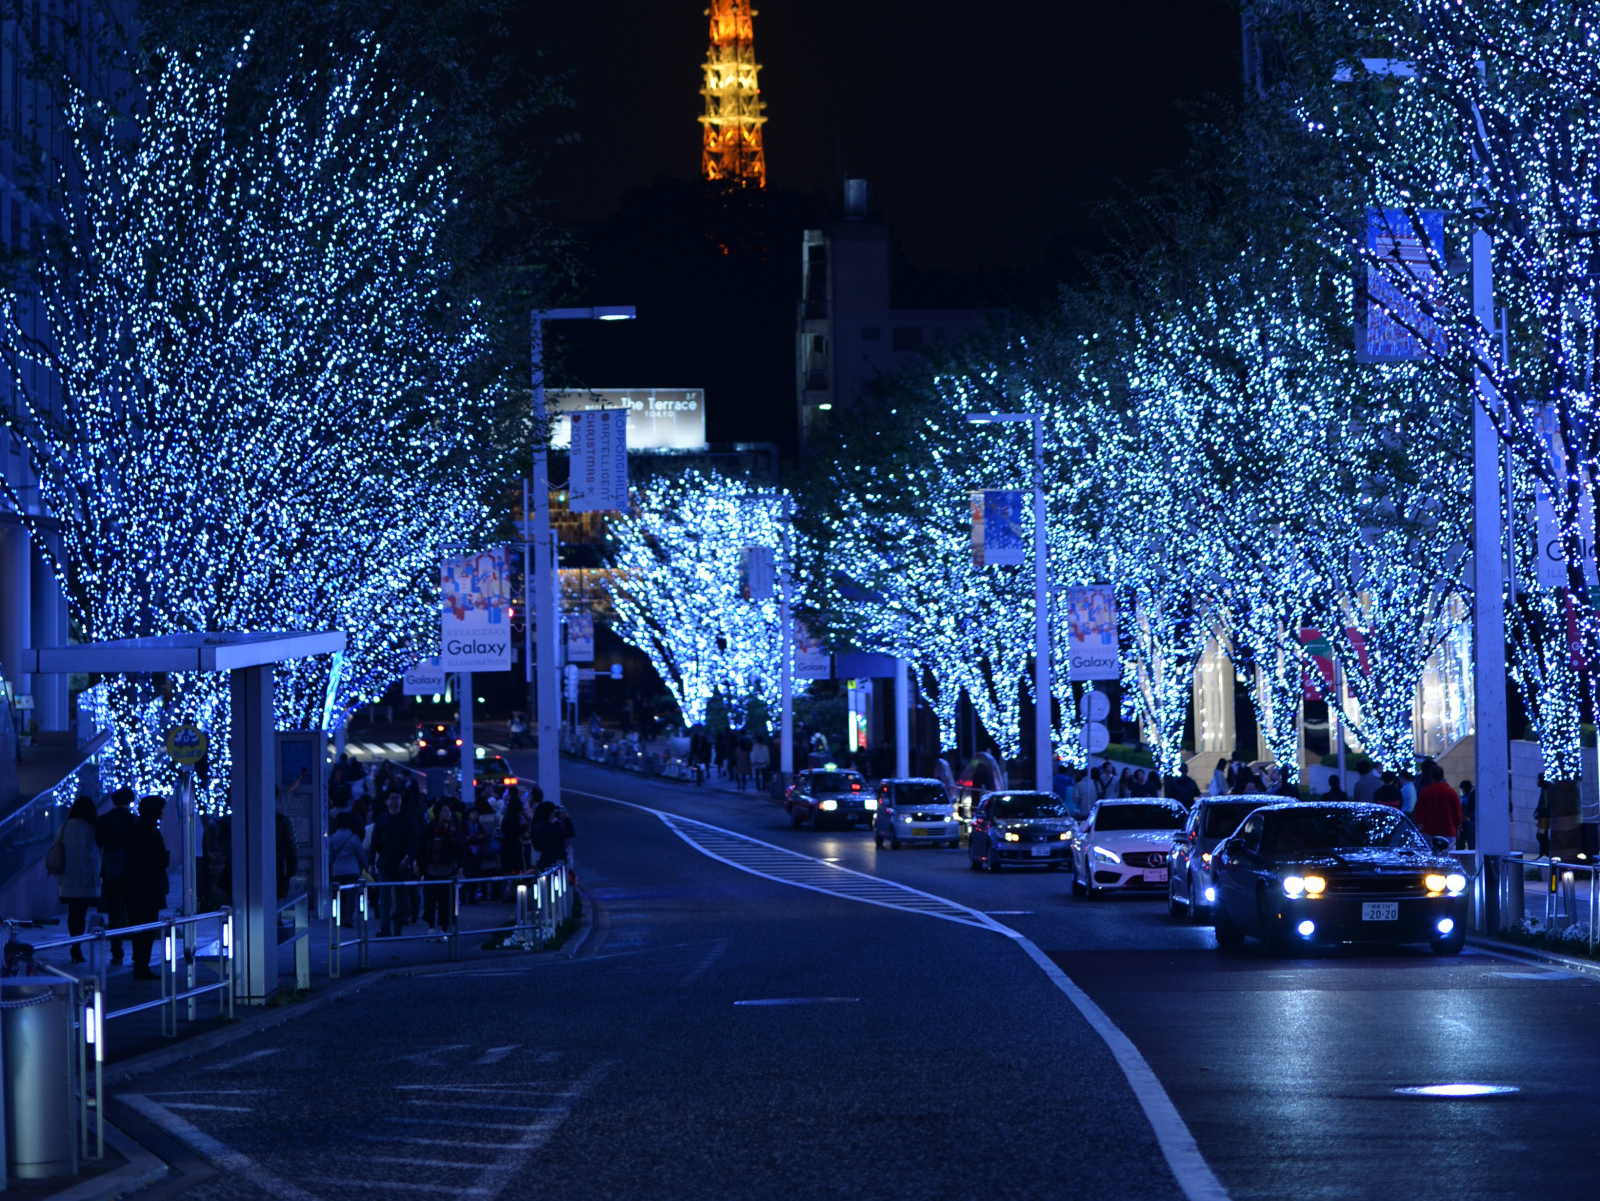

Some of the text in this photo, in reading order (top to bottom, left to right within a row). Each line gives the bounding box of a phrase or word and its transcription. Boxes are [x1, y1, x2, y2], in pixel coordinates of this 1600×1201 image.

[620, 397, 644, 411] The
[647, 397, 698, 411] Terrace
[572, 425, 582, 456] 2015
[585, 412, 596, 484] CHRISTMAS
[600, 423, 611, 502] ARTELLIGENT
[615, 410, 626, 508] ROPPONGI HILLS
[447, 638, 507, 657] Galaxy
[798, 662, 828, 672] Galaxy
[1072, 656, 1116, 669] Galaxy
[406, 675, 443, 686] Galaxy
